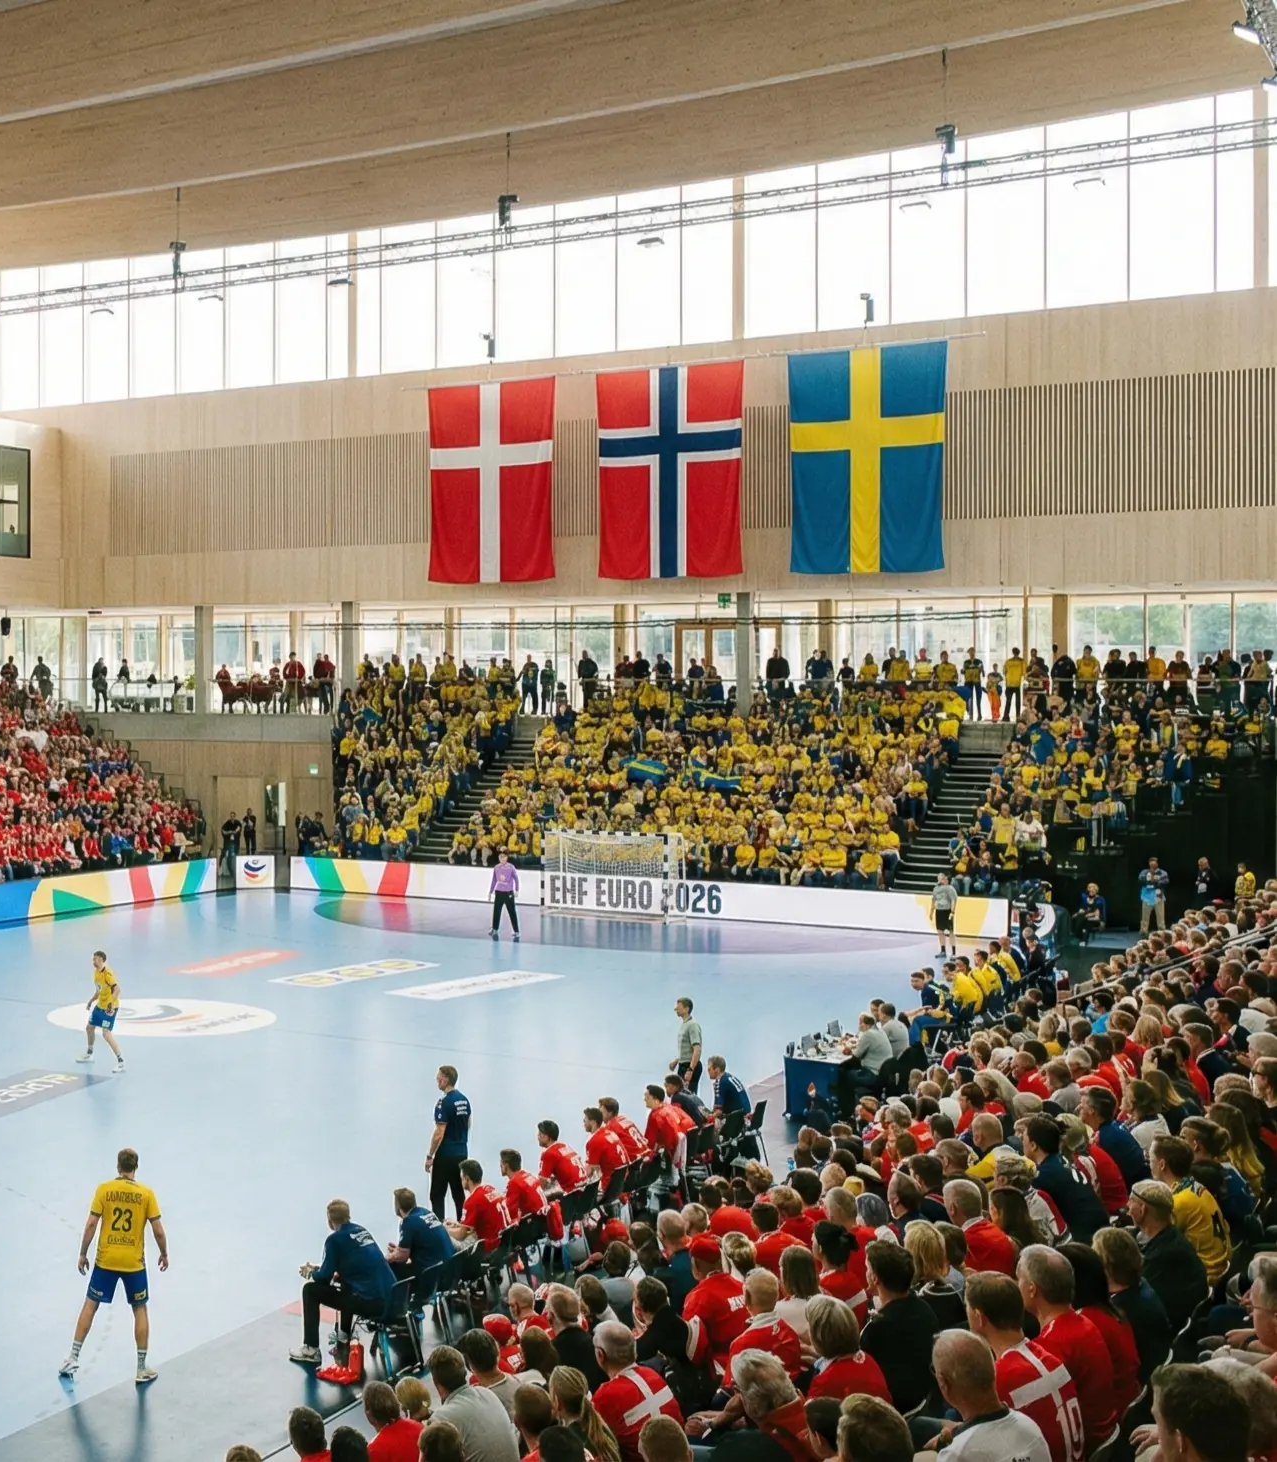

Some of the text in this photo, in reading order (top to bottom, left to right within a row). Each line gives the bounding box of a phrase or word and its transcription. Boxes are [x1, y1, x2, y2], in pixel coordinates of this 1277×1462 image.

[549, 874, 588, 905] EHF
[595, 877, 652, 911] EURO
[111, 1206, 133, 1233] 23
